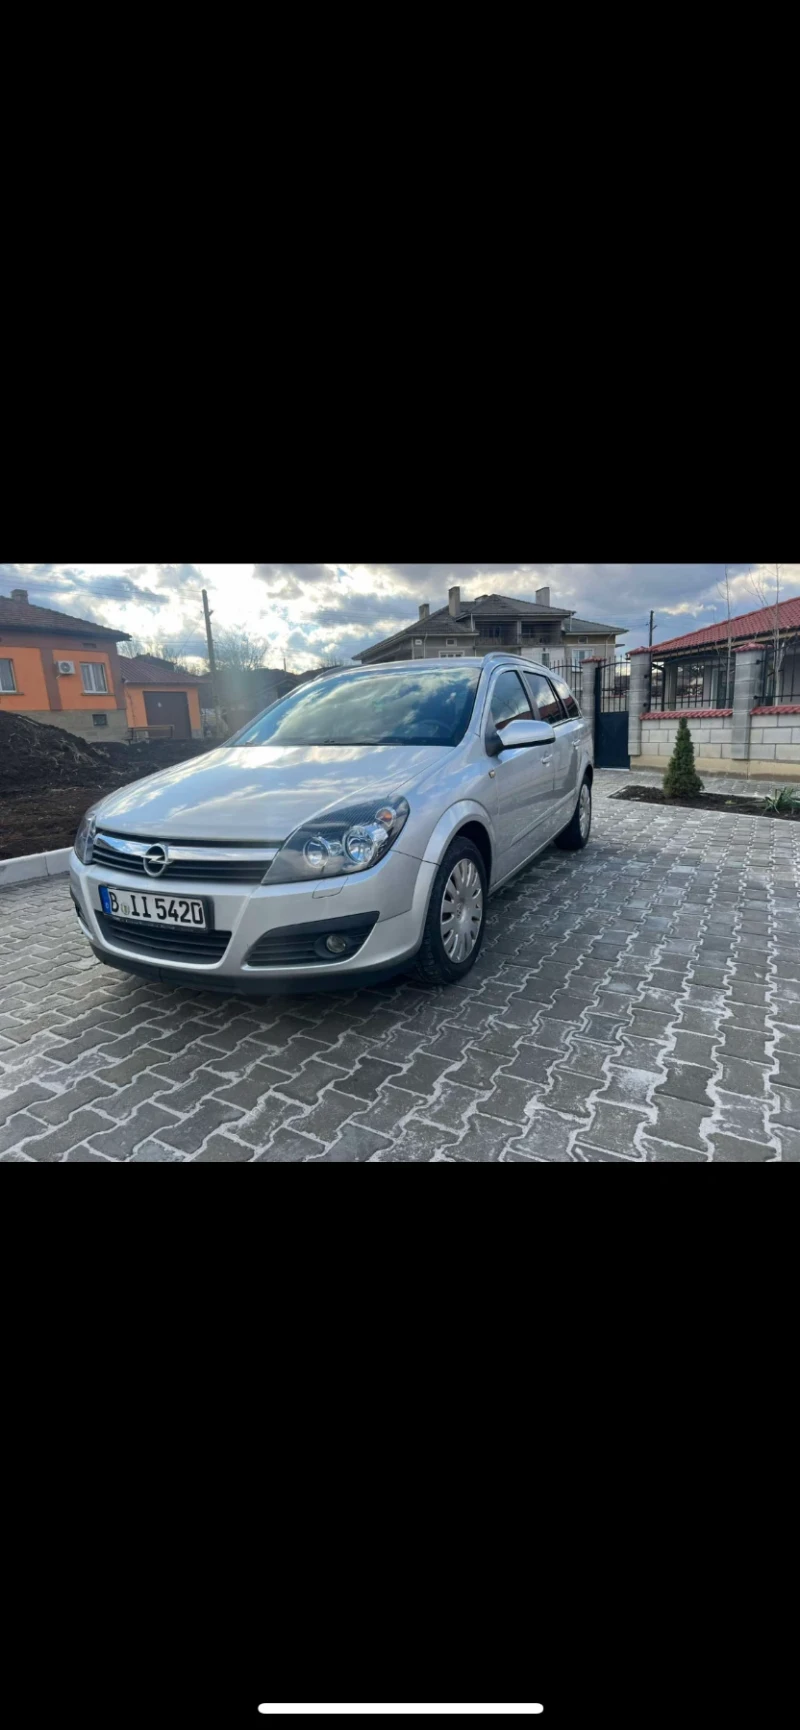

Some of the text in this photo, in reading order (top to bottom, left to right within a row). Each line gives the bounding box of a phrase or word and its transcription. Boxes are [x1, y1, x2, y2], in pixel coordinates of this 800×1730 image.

[109, 891, 119, 913] B
[130, 894, 152, 918] II
[154, 898, 204, 925] 5420
